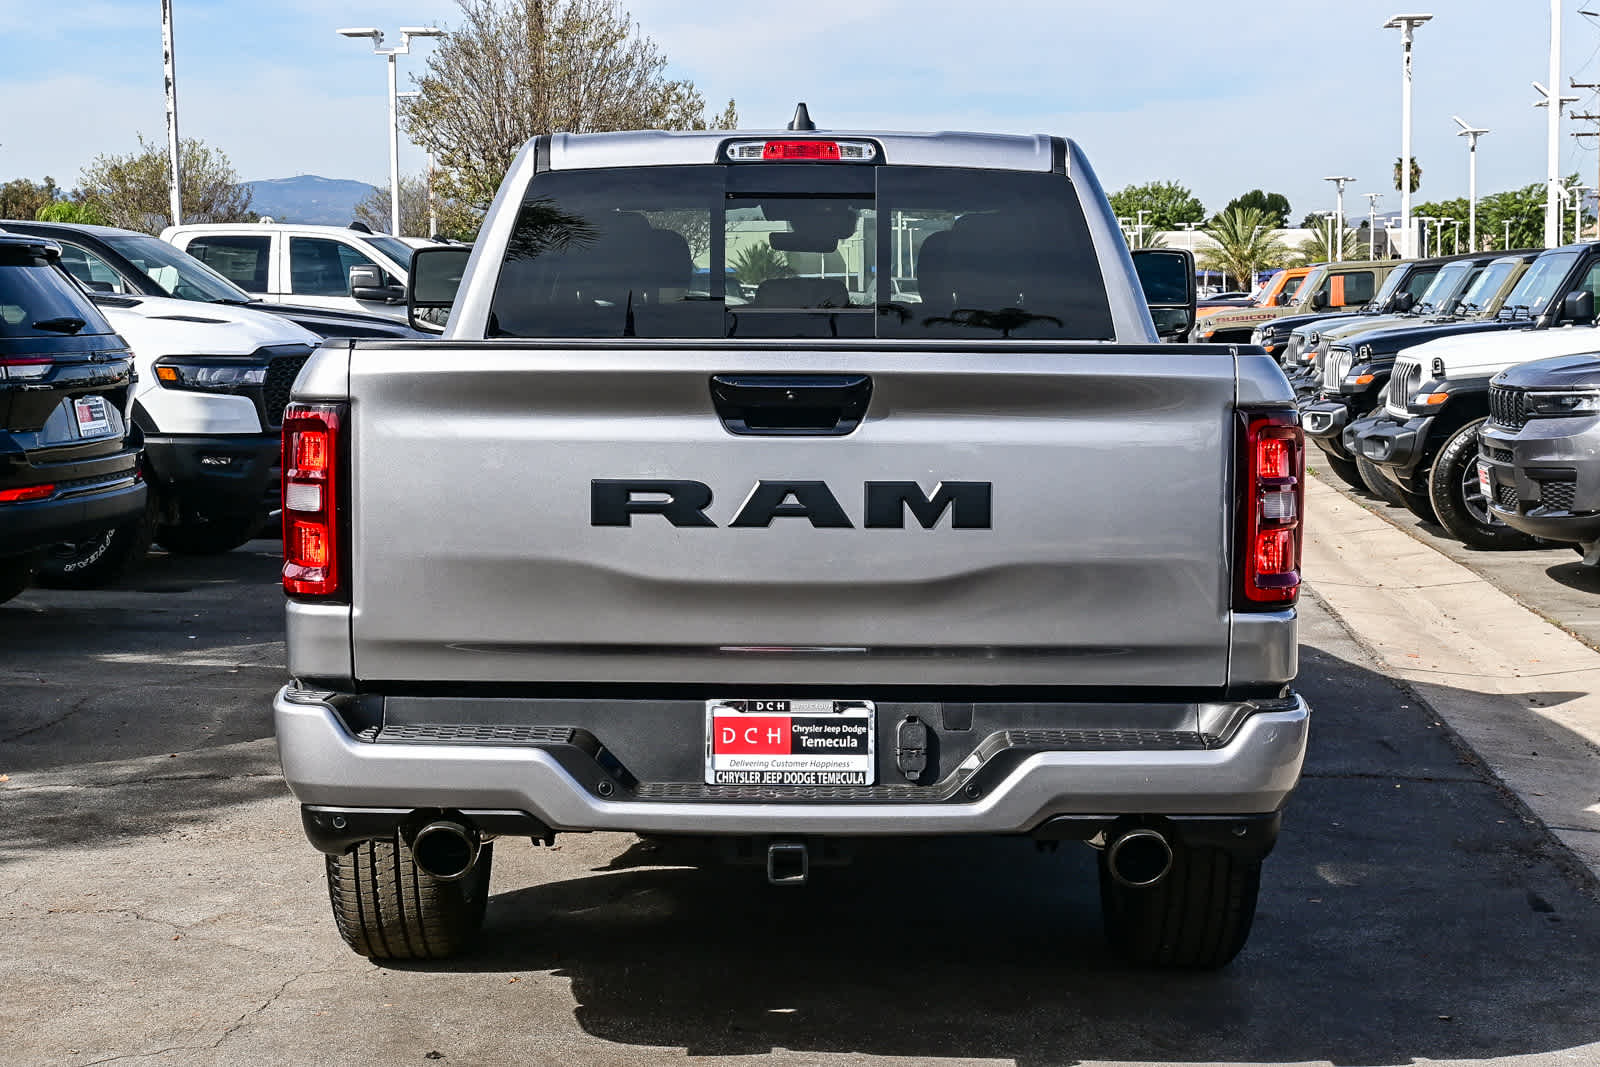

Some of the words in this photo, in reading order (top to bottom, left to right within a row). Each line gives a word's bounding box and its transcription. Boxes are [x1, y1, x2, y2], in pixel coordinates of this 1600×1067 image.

[590, 478, 992, 529] RAM
[756, 702, 785, 711] DCH
[722, 727, 782, 744] DCH
[791, 724, 823, 734] Chrysler
[824, 724, 841, 734] Jeep
[842, 725, 867, 735] Dodge
[800, 735, 858, 748] Temecula
[729, 759, 769, 768] Delivering
[770, 760, 808, 768] Customer
[809, 760, 850, 769] Happiness
[716, 771, 761, 784] CHRYSLER
[762, 772, 782, 784] JEEP
[783, 772, 816, 784] DODGE
[817, 772, 865, 785] TEMECULA
